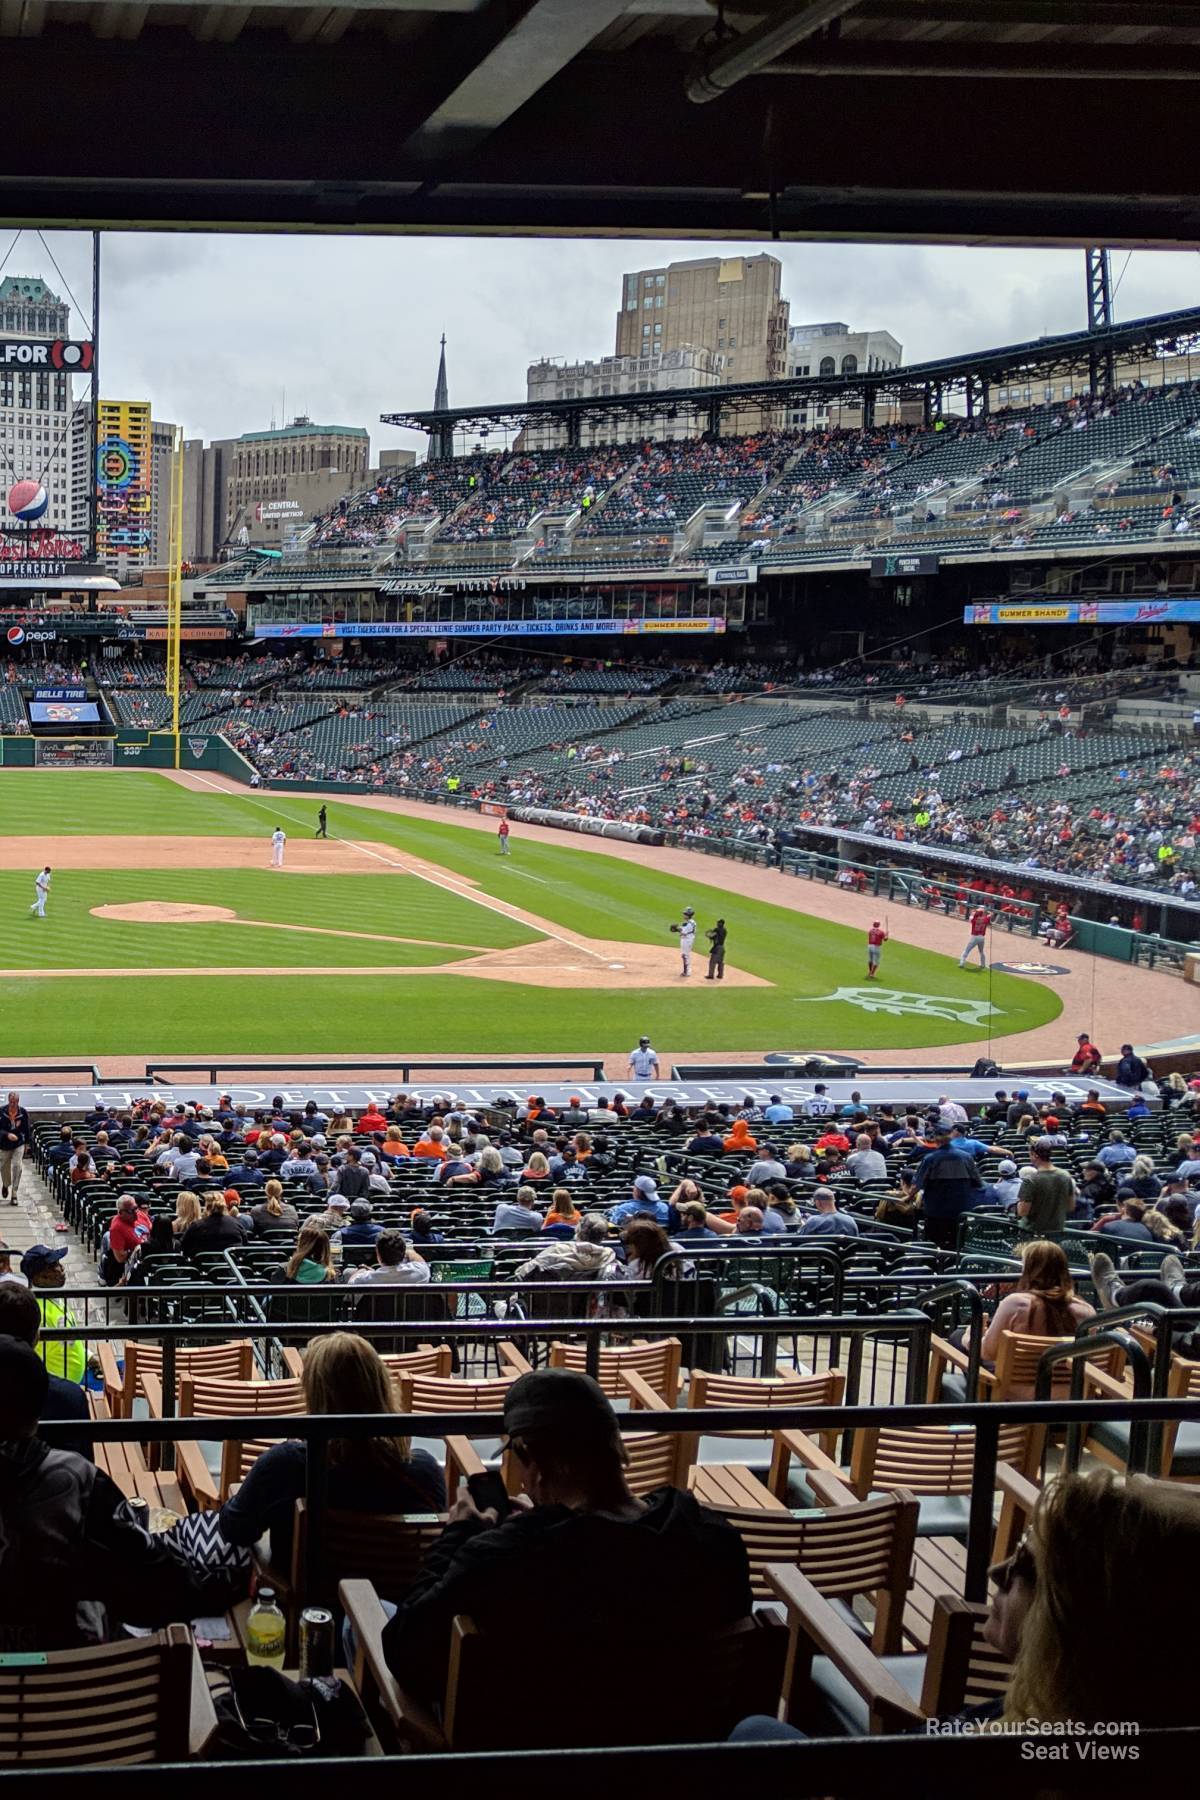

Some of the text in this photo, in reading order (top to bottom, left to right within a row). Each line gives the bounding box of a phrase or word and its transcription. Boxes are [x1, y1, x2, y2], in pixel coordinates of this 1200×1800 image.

[268, 501, 299, 509] CENTRAL
[501, 578, 526, 590] CLUB
[482, 624, 500, 632] PARTY
[26, 630, 56, 643] pepsi
[36, 689, 85, 698] BELLE TIRE
[812, 1104, 827, 1115] 37
